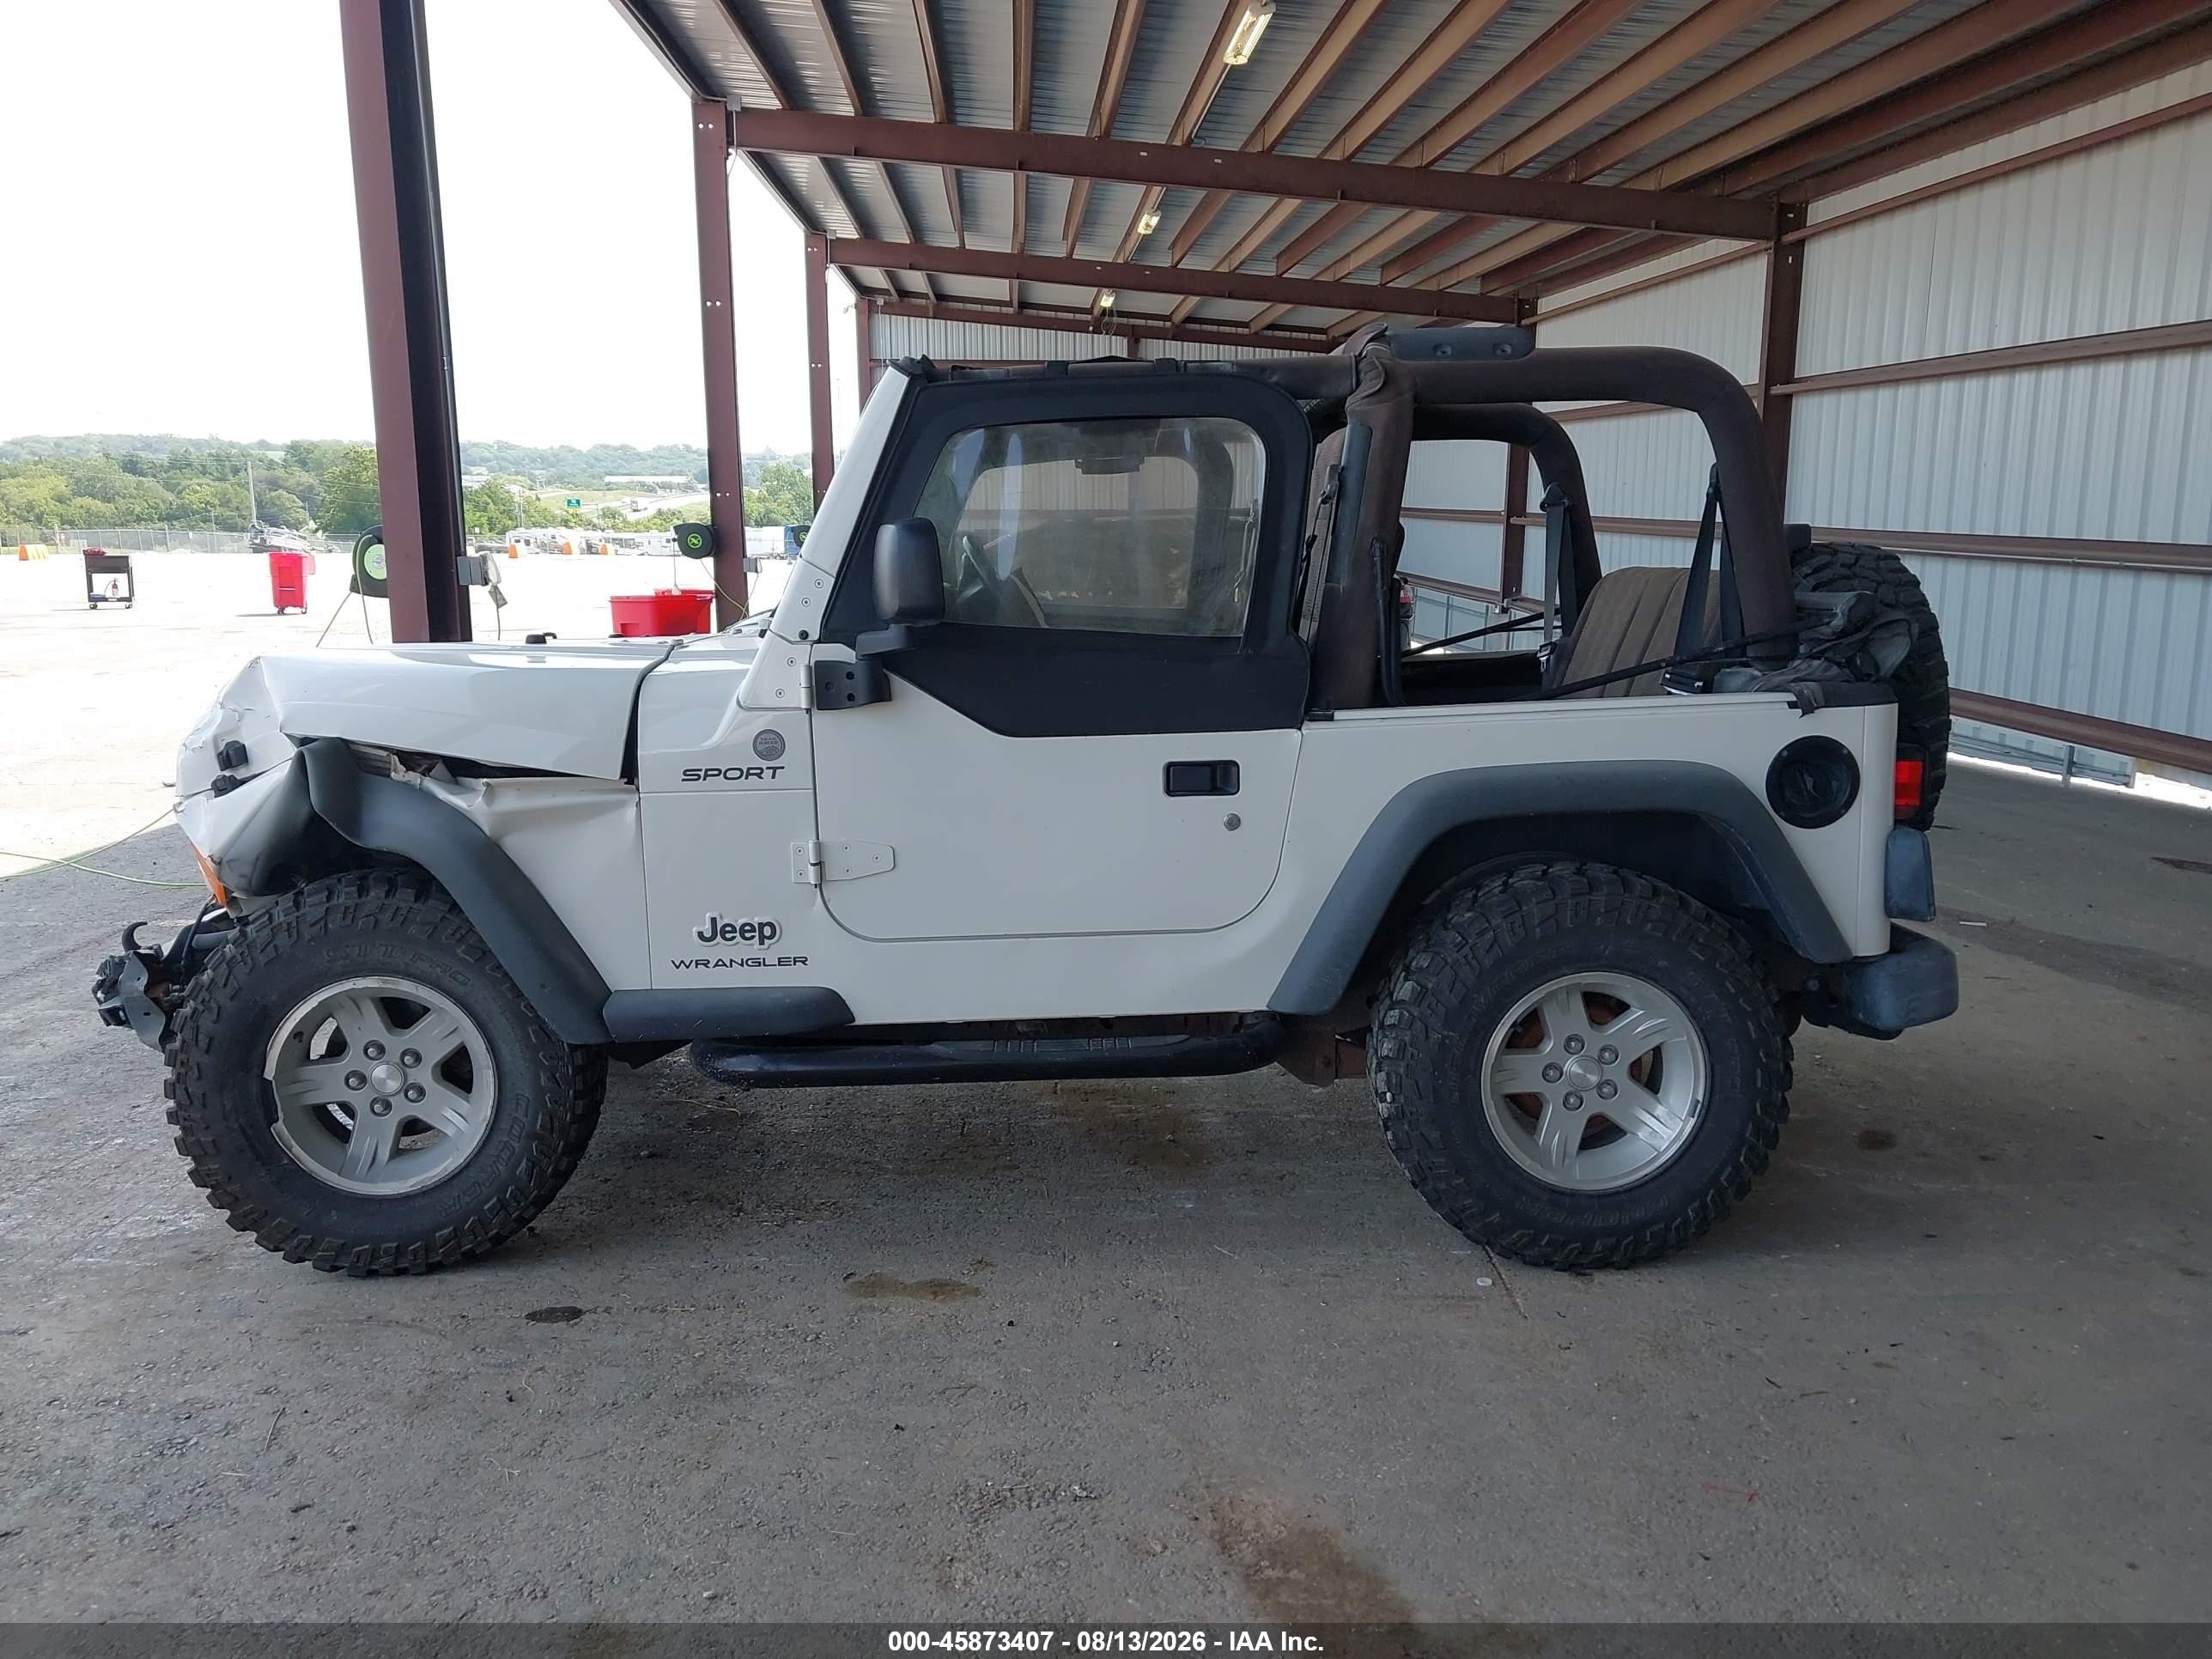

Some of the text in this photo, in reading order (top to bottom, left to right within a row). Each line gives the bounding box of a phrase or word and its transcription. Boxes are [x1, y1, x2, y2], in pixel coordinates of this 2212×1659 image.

[681, 766, 785, 782] SPORT
[696, 916, 778, 946] Jeep
[670, 956, 810, 970] WRANGLER
